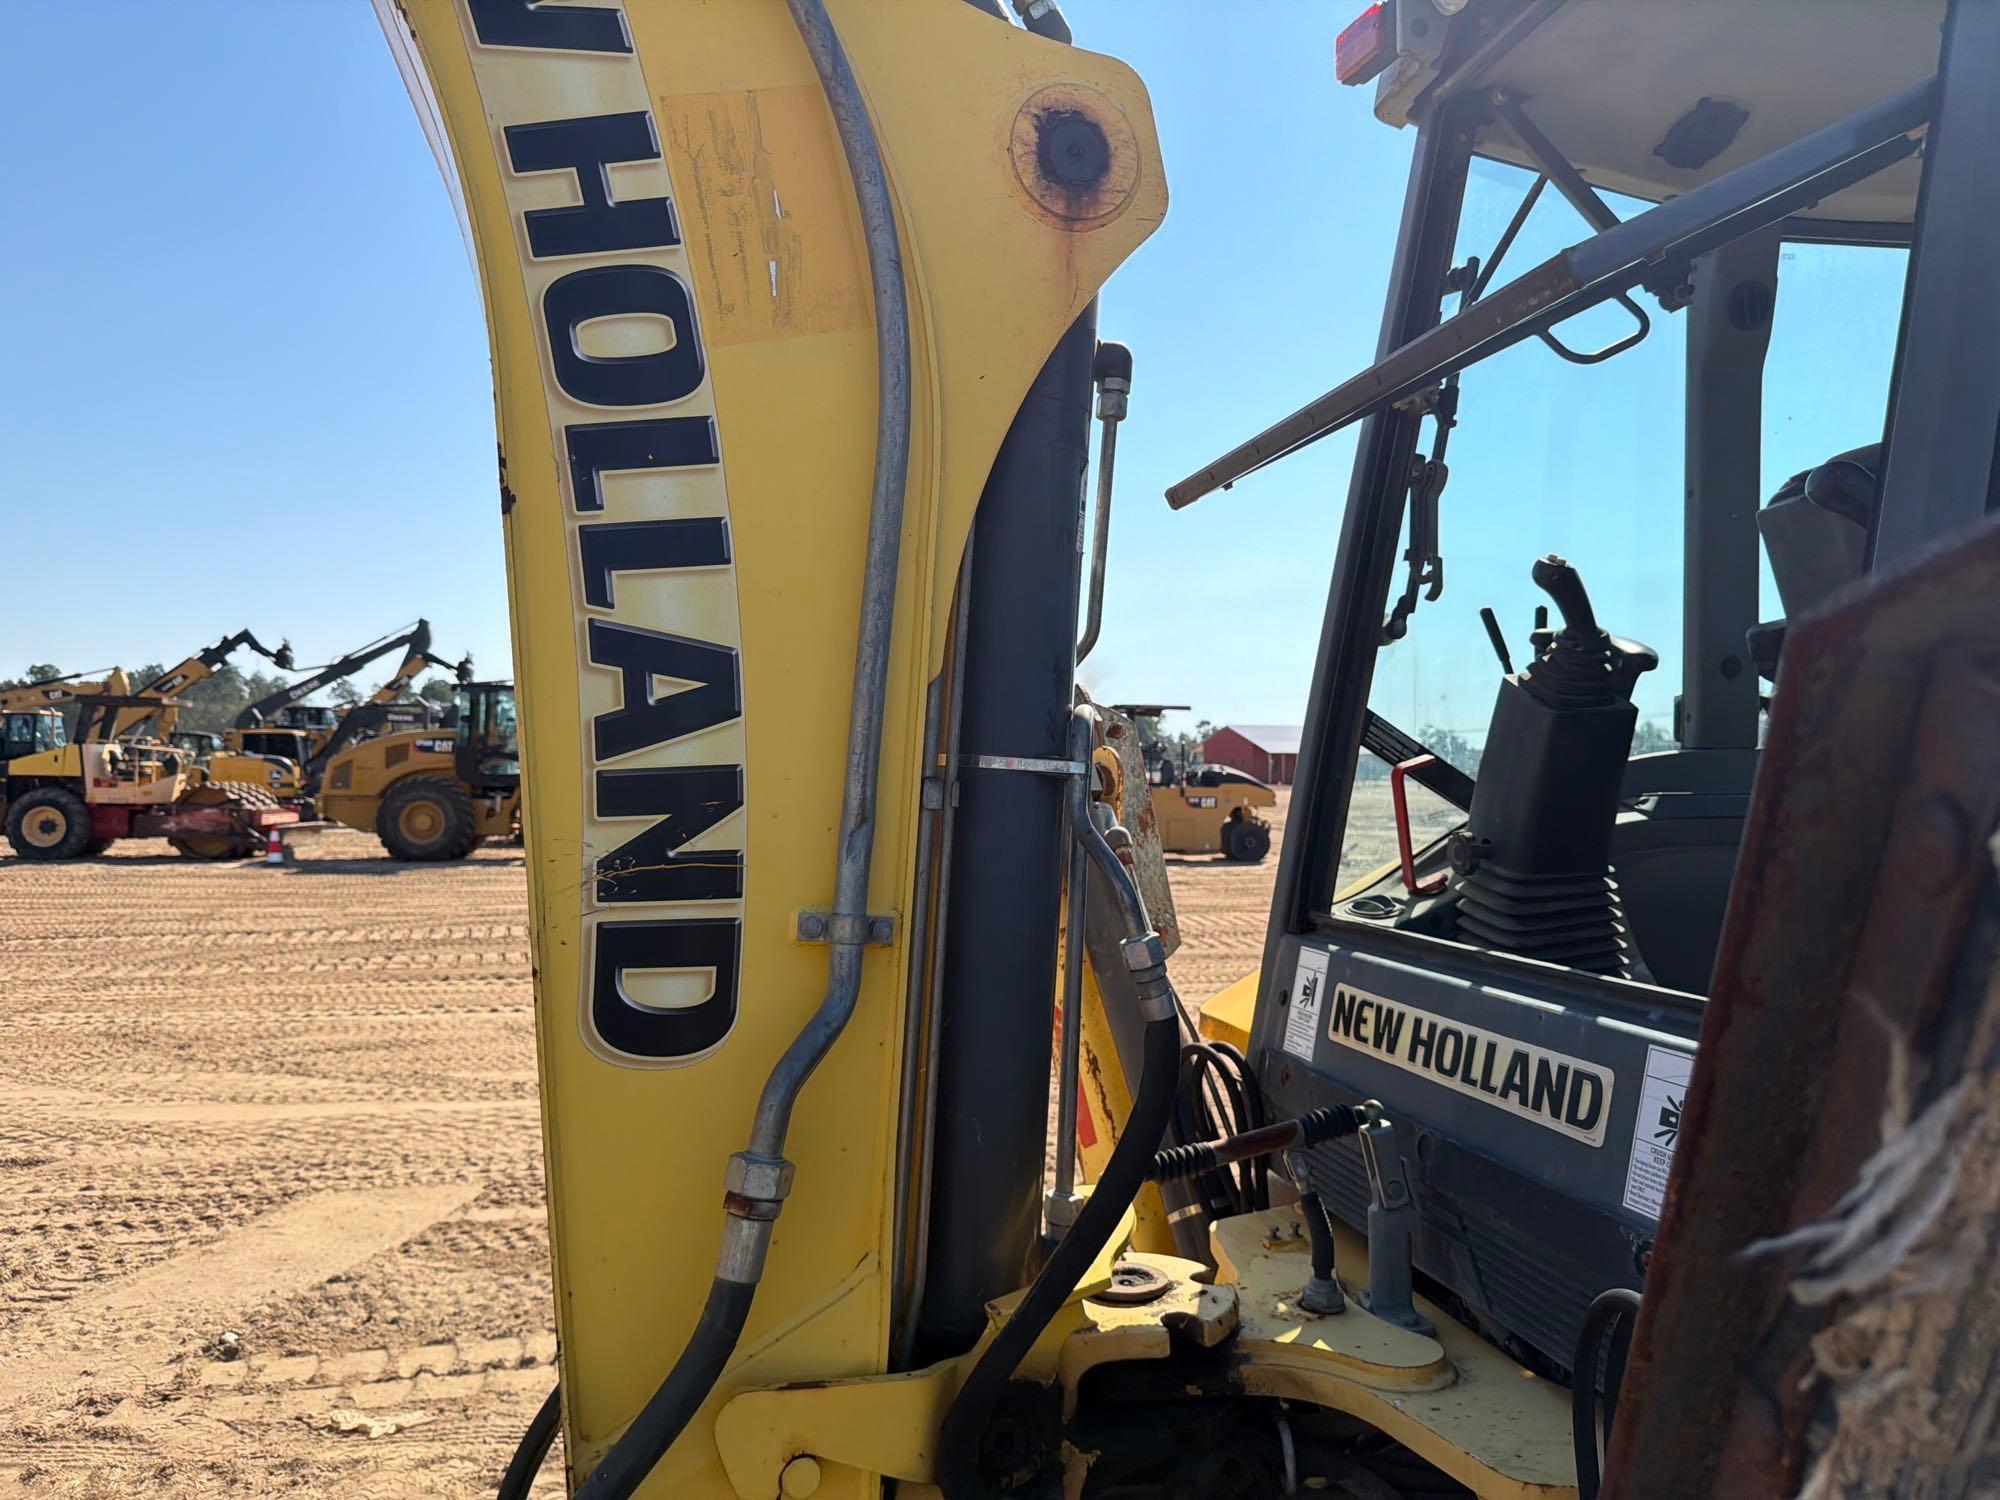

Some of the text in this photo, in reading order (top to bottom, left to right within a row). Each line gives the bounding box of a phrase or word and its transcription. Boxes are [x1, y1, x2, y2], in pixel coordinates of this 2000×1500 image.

[503, 110, 745, 1058] HOLLAND
[434, 739, 454, 752] CAT
[1332, 989, 1604, 1131] NEW HOLLAND
